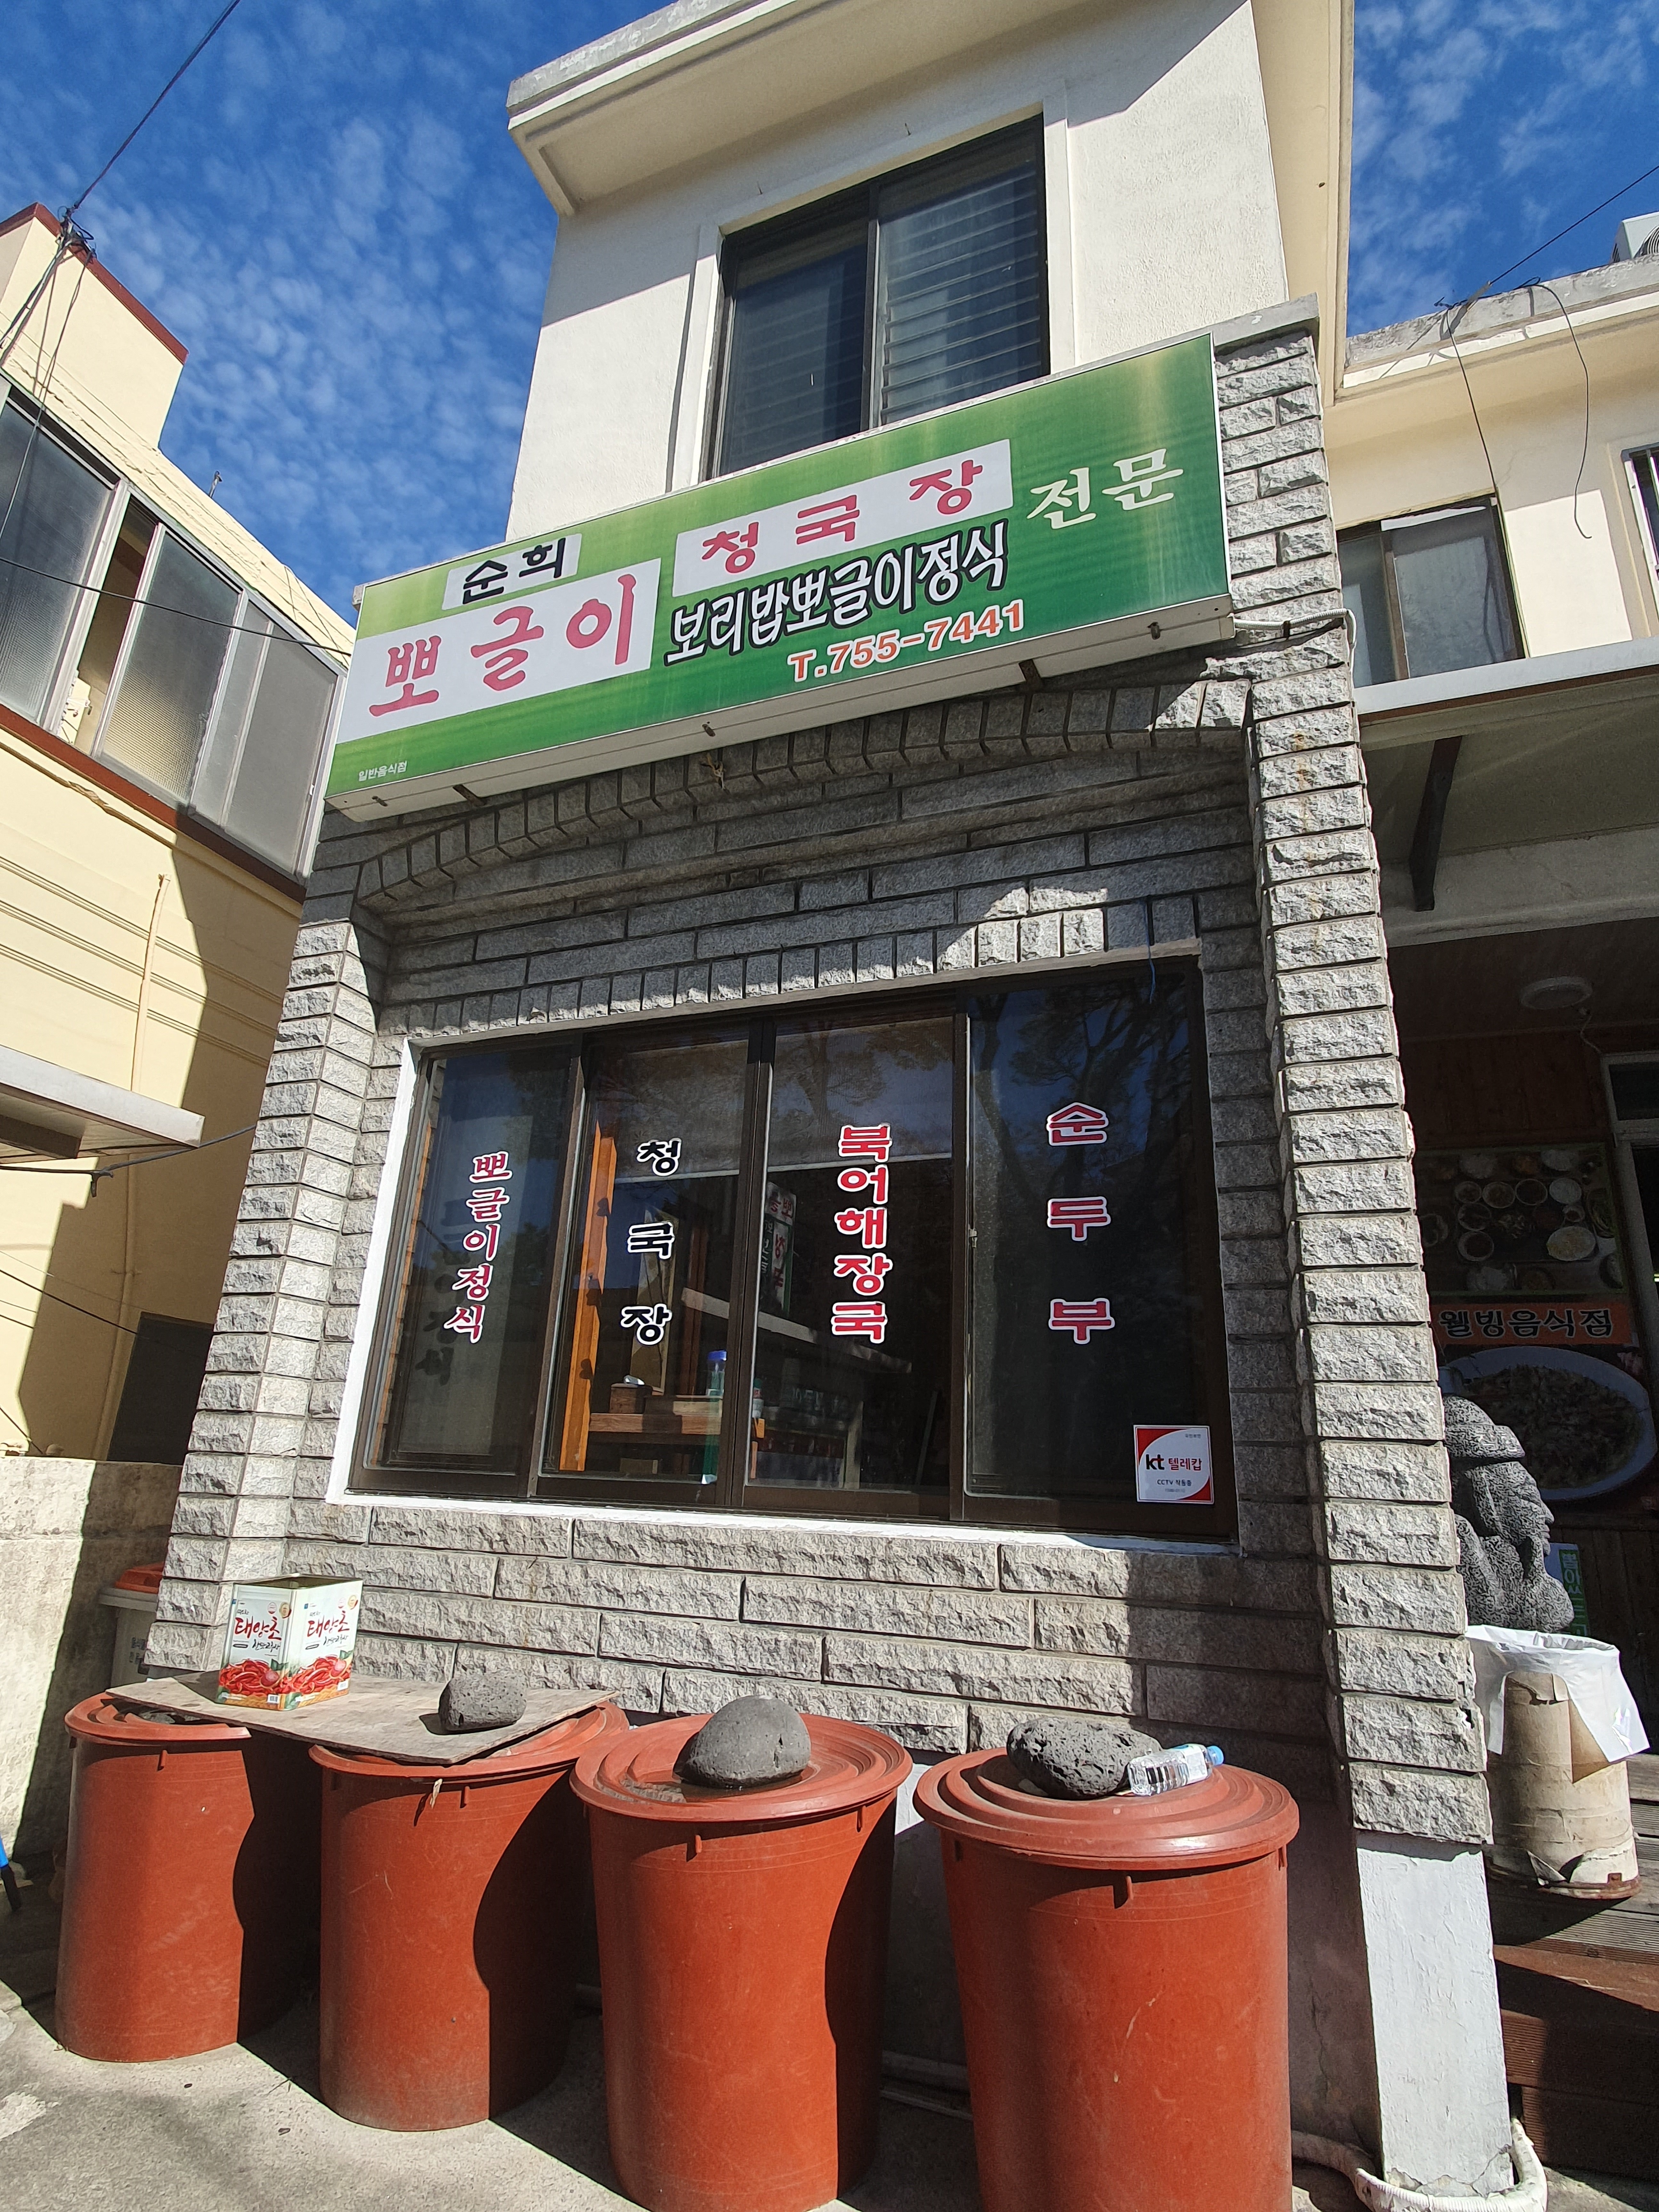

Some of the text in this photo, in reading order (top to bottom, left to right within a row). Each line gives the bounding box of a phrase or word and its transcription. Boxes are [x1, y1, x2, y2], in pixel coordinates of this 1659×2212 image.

[702, 458, 984, 574] 청국장
[1026, 448, 1184, 530] 전문
[462, 537, 566, 604] 순희
[369, 574, 637, 717] 뽀글이
[787, 599, 1025, 682] T.755-7441
[444, 1151, 512, 1344] 뽀글이정식
[621, 1138, 682, 1345] 청국장
[830, 1122, 893, 1344] 북어해장국
[1046, 1102, 1115, 1344] 순두부
[1439, 1309, 1613, 1338] 웰빙음식점
[1146, 1454, 1202, 1471] kt 텔레캅
[235, 1616, 282, 1641] 태양초
[307, 1611, 350, 1637] 태양초
